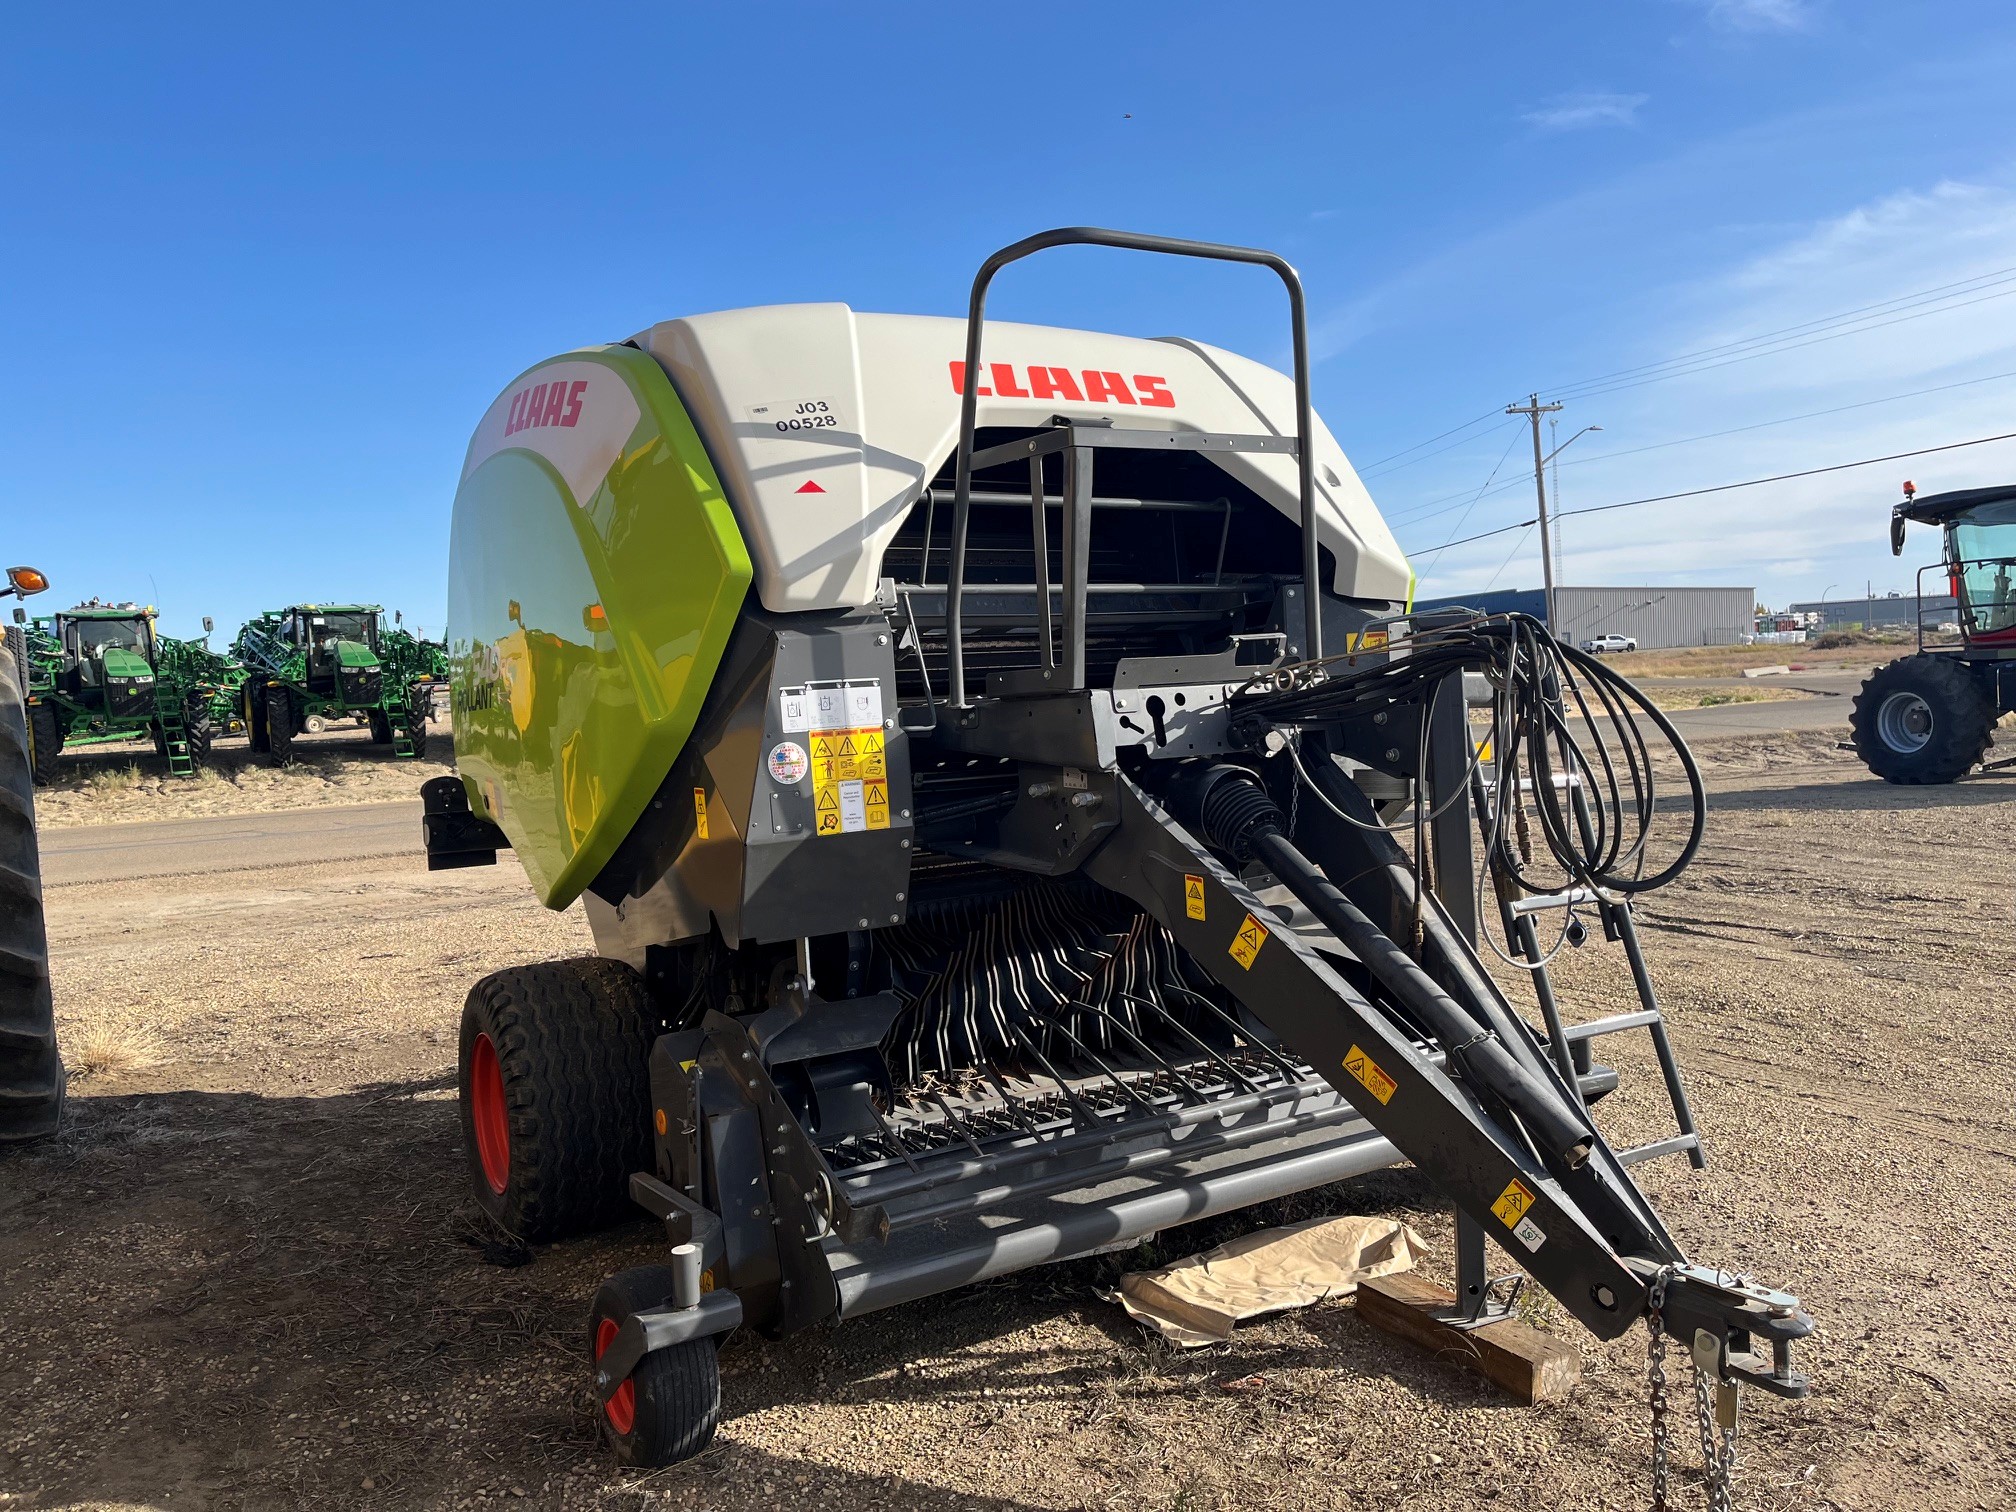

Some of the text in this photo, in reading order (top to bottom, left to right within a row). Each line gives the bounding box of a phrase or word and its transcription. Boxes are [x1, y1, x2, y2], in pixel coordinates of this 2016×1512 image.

[949, 361, 1176, 408] CLAAS
[505, 381, 588, 438] CLAAS
[775, 415, 837, 432] 00528
